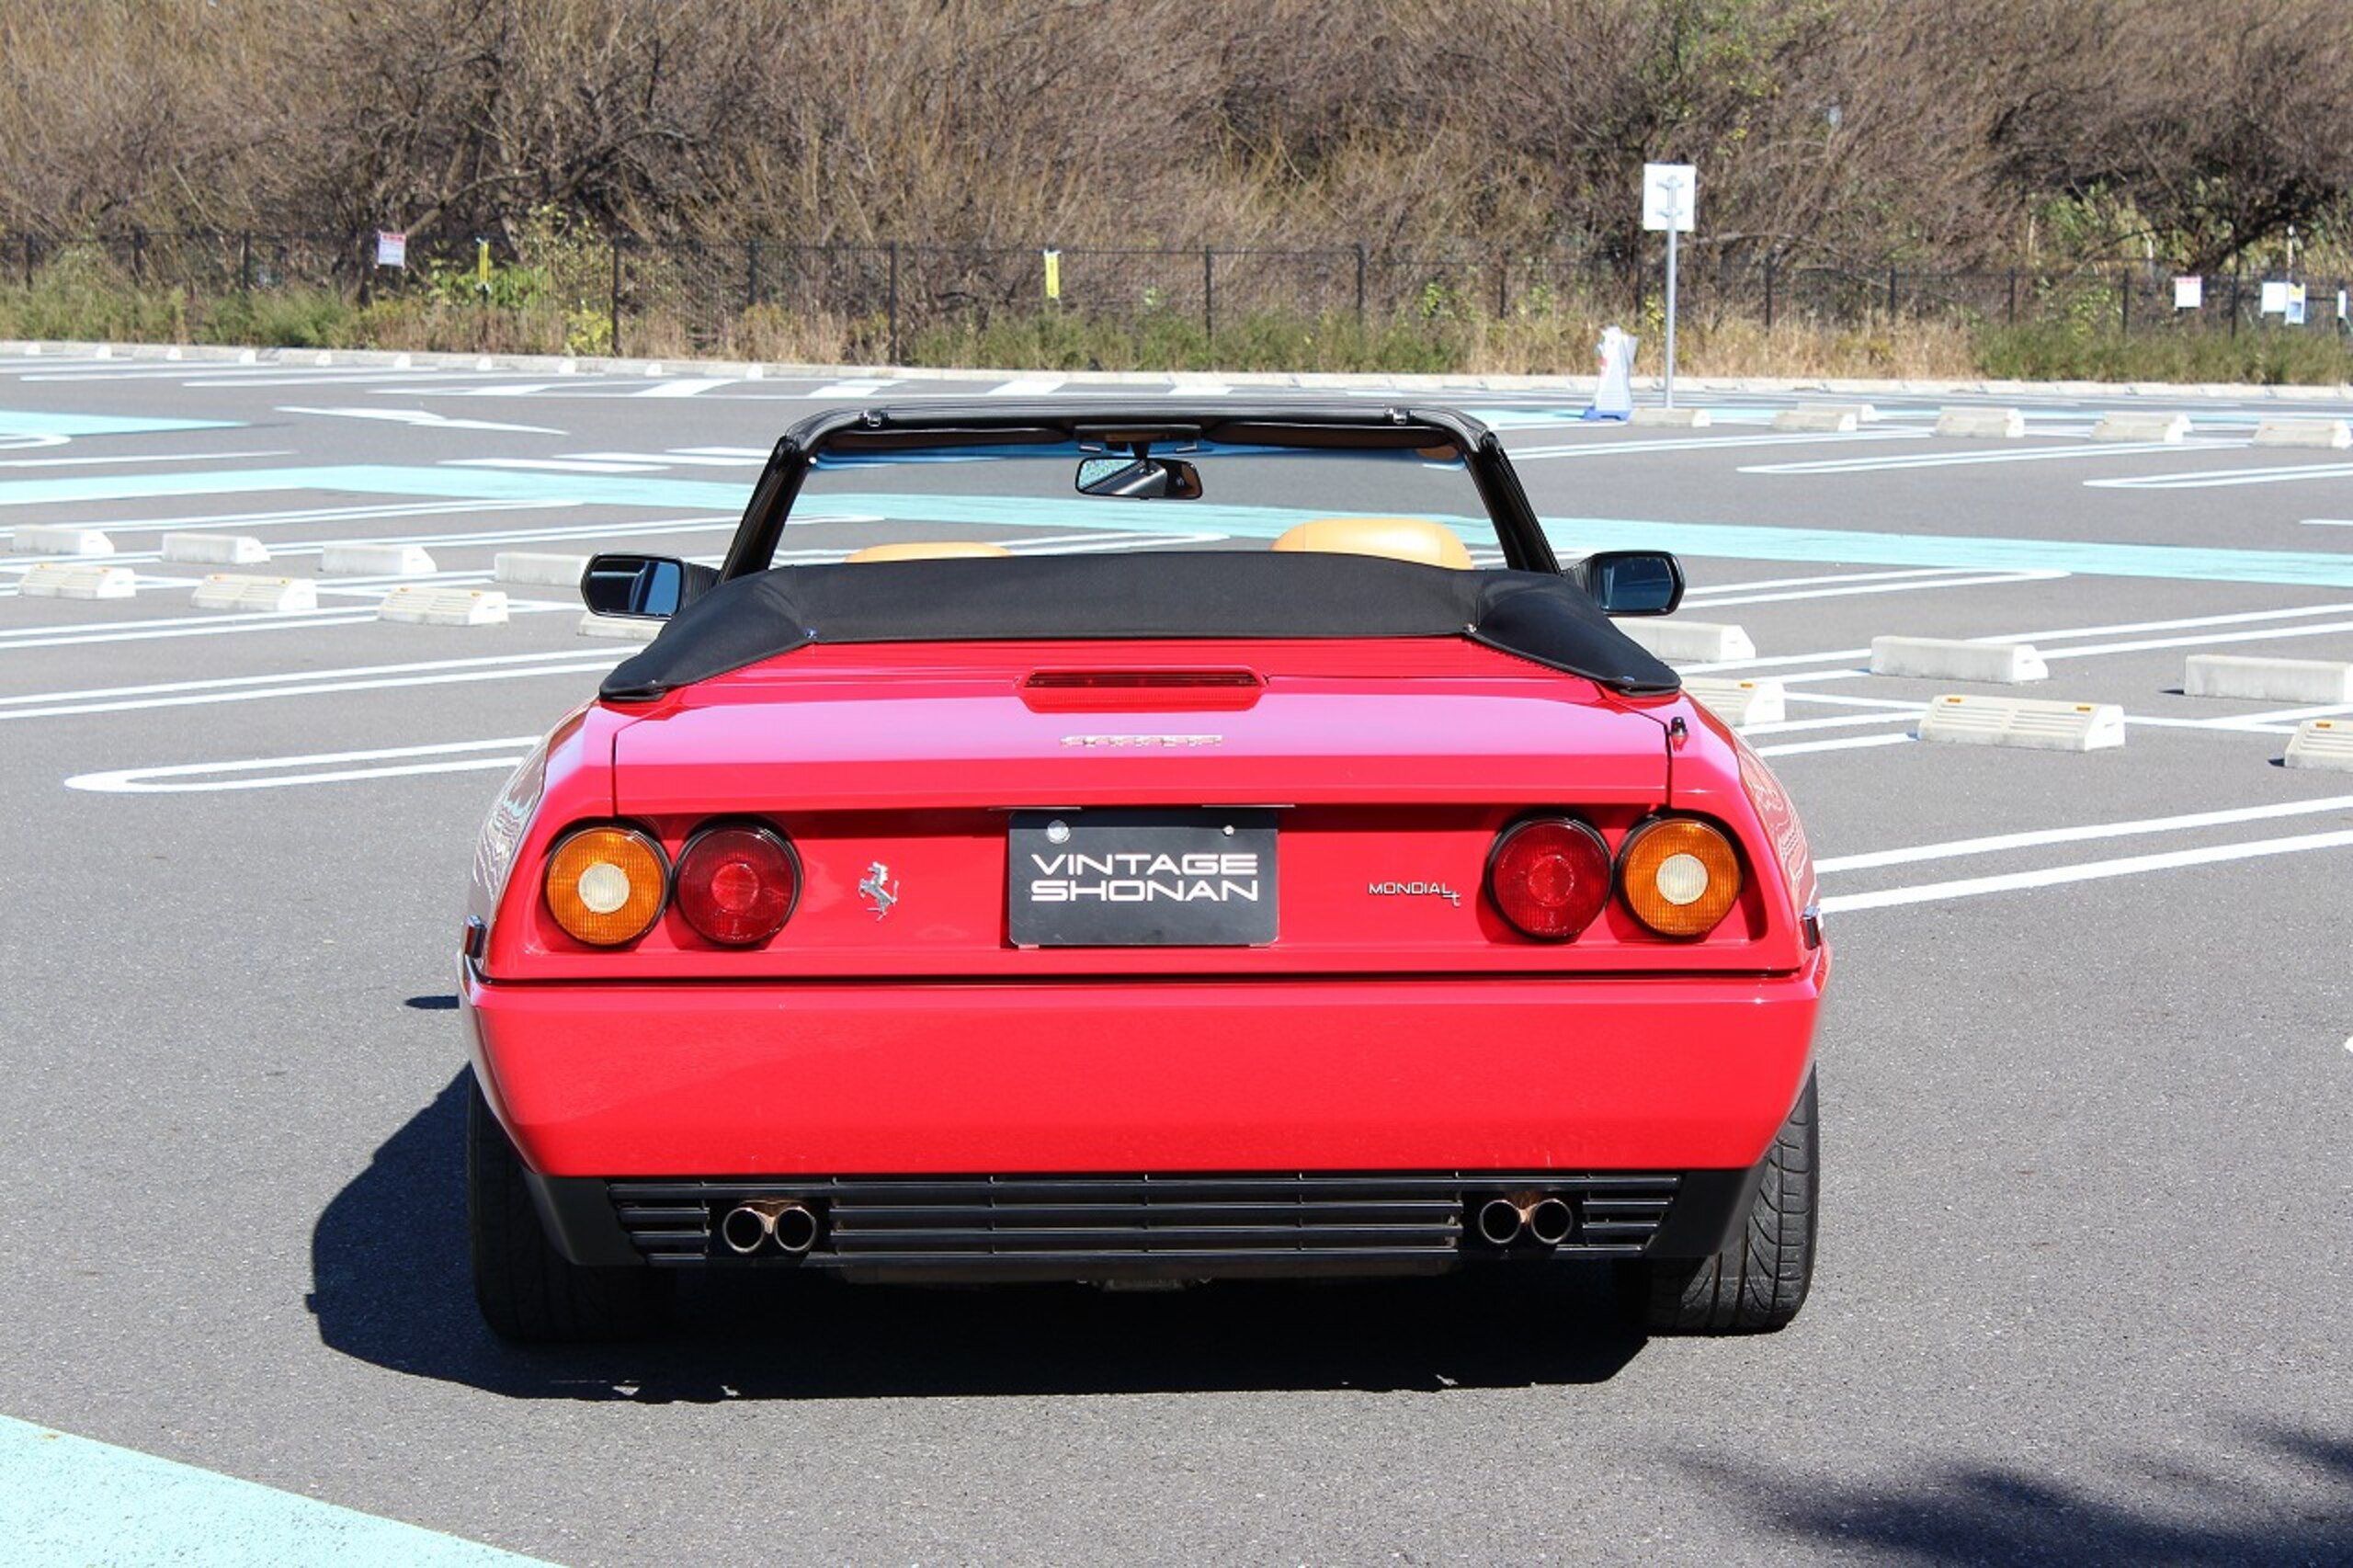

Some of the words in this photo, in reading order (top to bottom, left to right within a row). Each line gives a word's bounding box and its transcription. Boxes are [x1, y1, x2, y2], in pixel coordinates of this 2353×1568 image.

[1030, 853, 1258, 876] VINTAGE
[1030, 879, 1259, 903] SHONAN
[1369, 881, 1451, 895] MONDIAL
